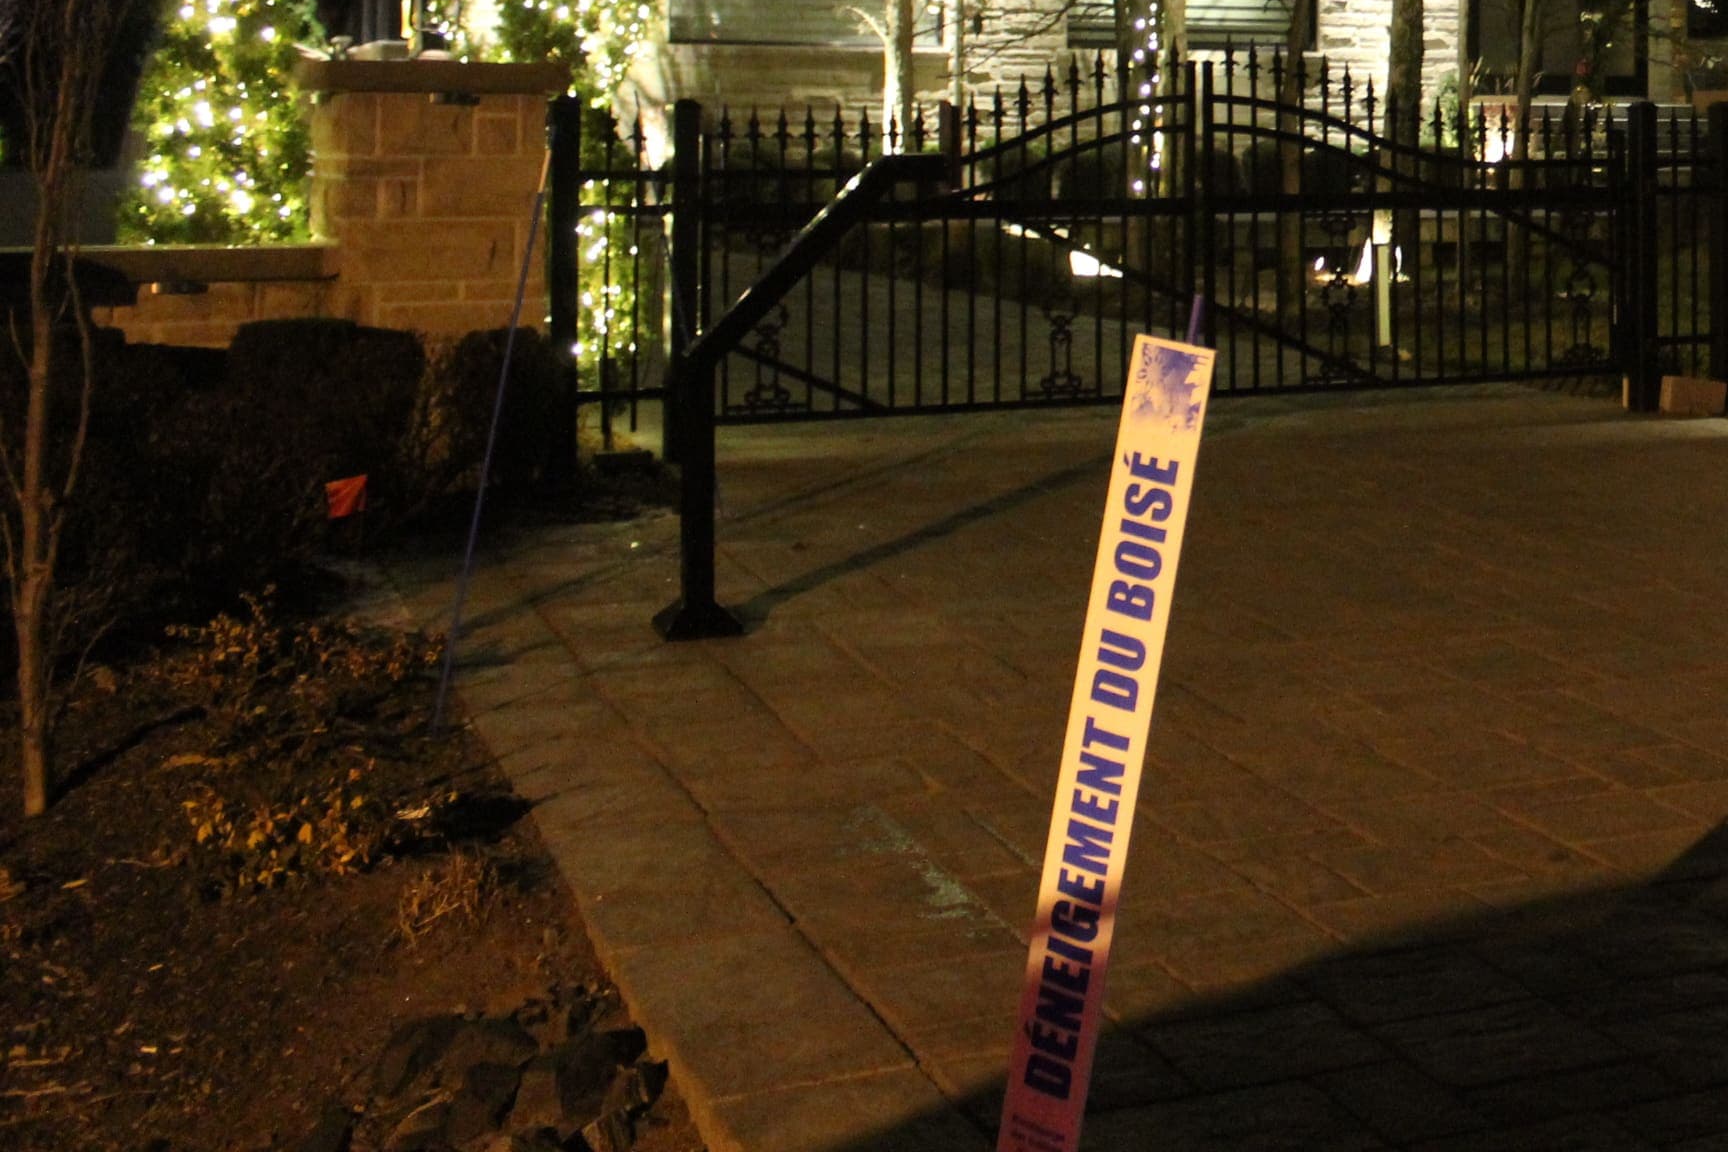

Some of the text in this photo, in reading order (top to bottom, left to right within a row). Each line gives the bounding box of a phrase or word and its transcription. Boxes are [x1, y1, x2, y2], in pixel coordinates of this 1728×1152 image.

[1105, 448, 1180, 621] BOISÉ
[1090, 628, 1146, 712] DU
[1023, 715, 1131, 1100] DÉNEIGEMENT
